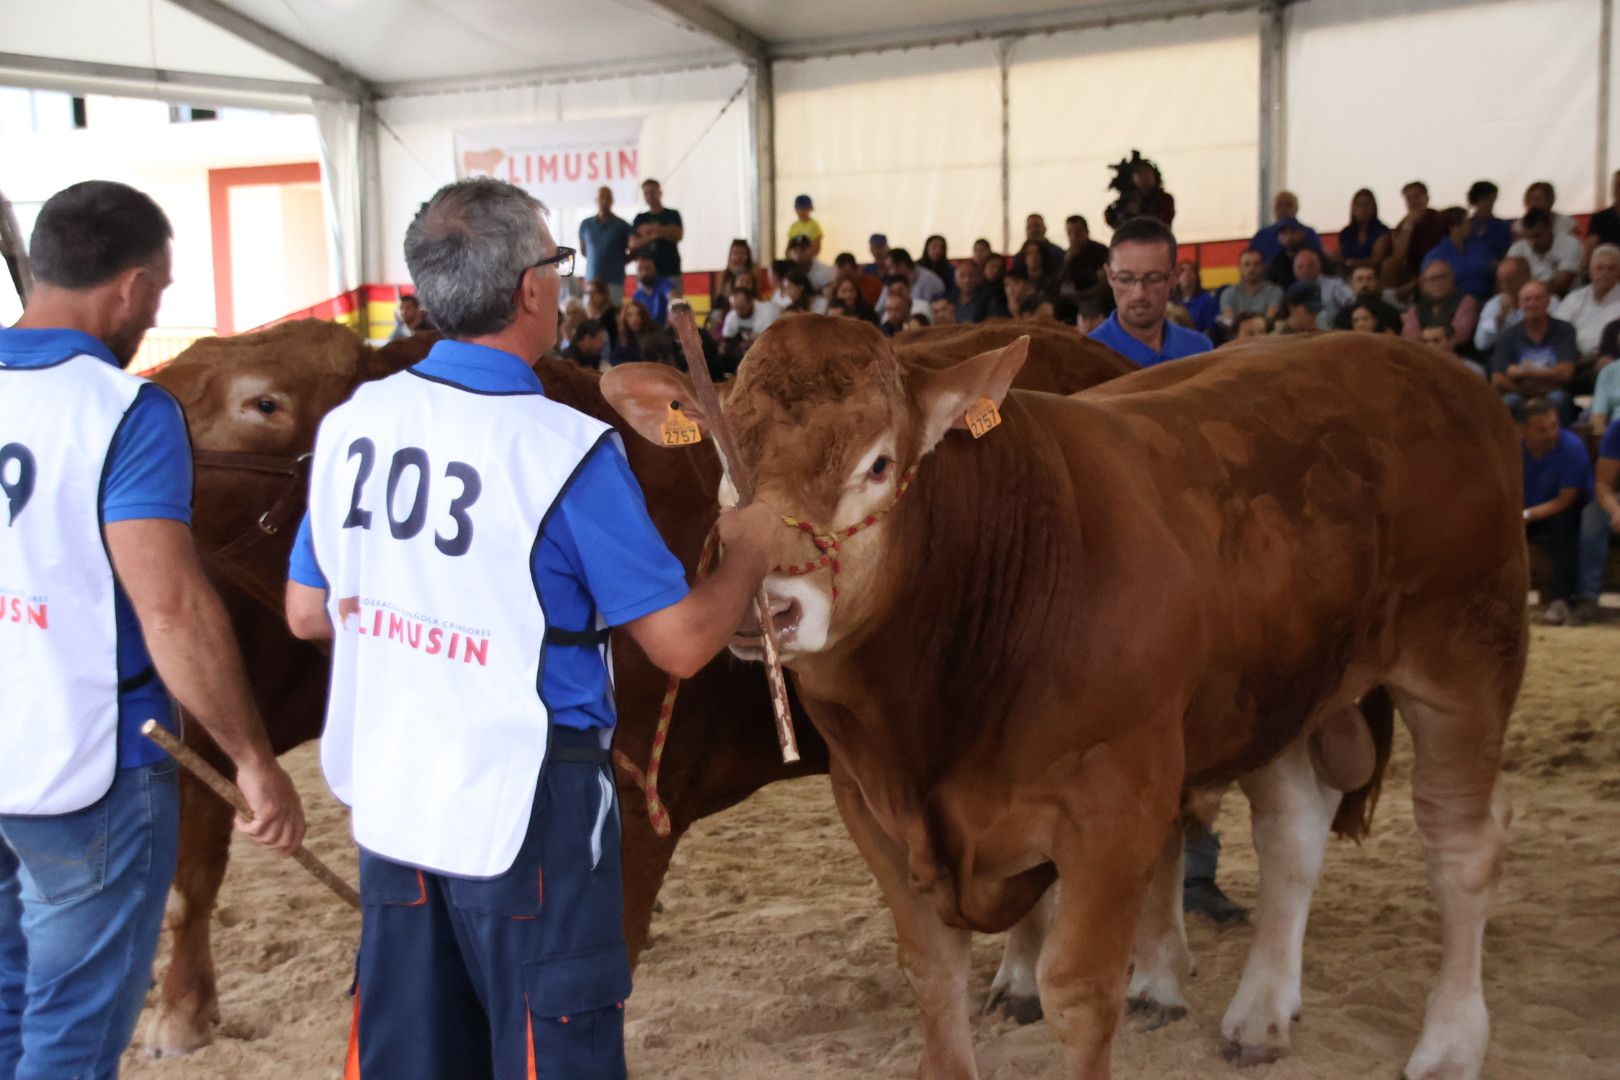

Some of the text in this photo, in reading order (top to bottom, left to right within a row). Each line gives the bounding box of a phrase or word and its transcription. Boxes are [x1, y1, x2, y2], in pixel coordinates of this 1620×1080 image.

[508, 150, 639, 184] LIMUSIN
[664, 429, 697, 444] 2757
[972, 408, 997, 437] 2757
[342, 436, 482, 557] 203
[358, 607, 489, 667] LIMUSIN
